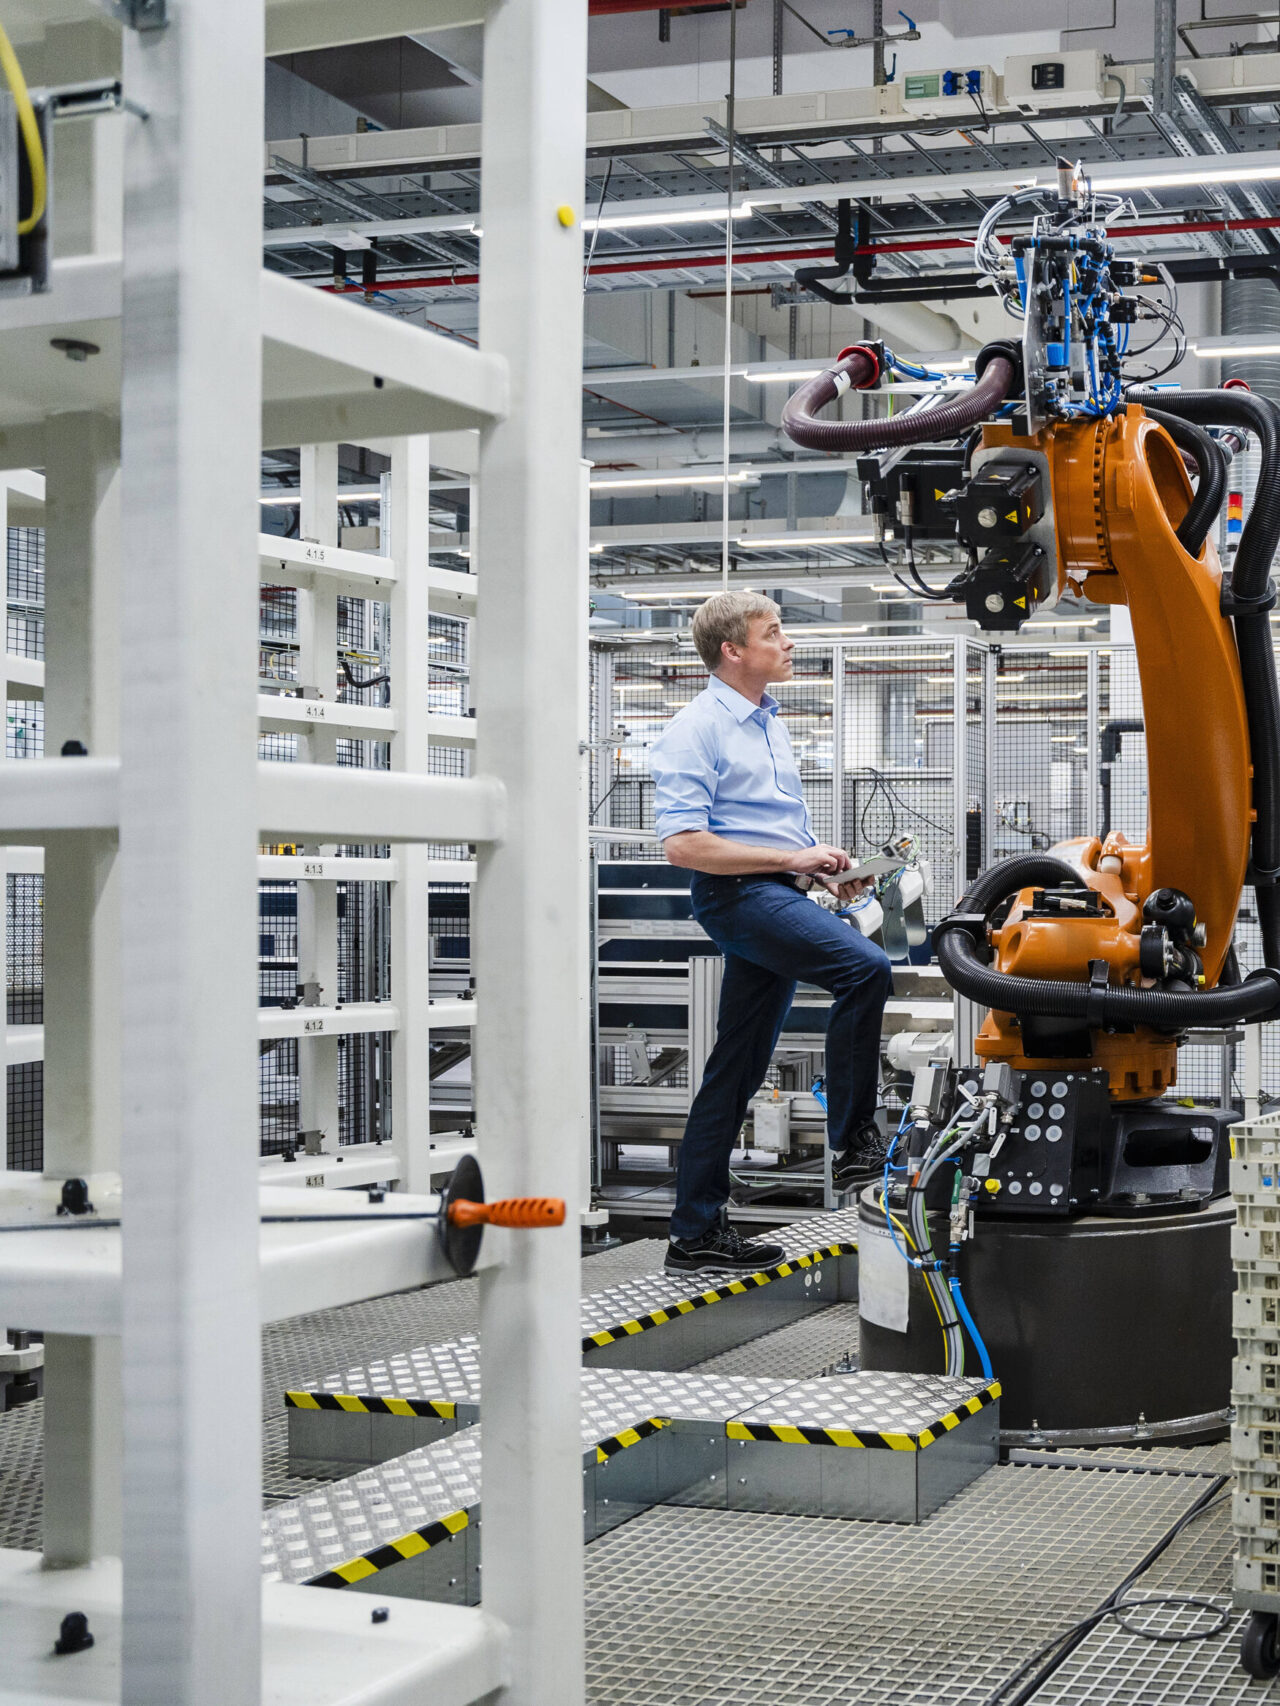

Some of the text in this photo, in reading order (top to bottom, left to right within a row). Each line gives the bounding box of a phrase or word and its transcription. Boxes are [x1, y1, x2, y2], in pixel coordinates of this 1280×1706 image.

[306, 548, 325, 560] 4.1.5
[306, 706, 325, 717] 4.1.4
[305, 864, 323, 874] 4.1.3
[305, 1020, 323, 1031] 4.1.2
[306, 1175, 324, 1186] 4.1.1
